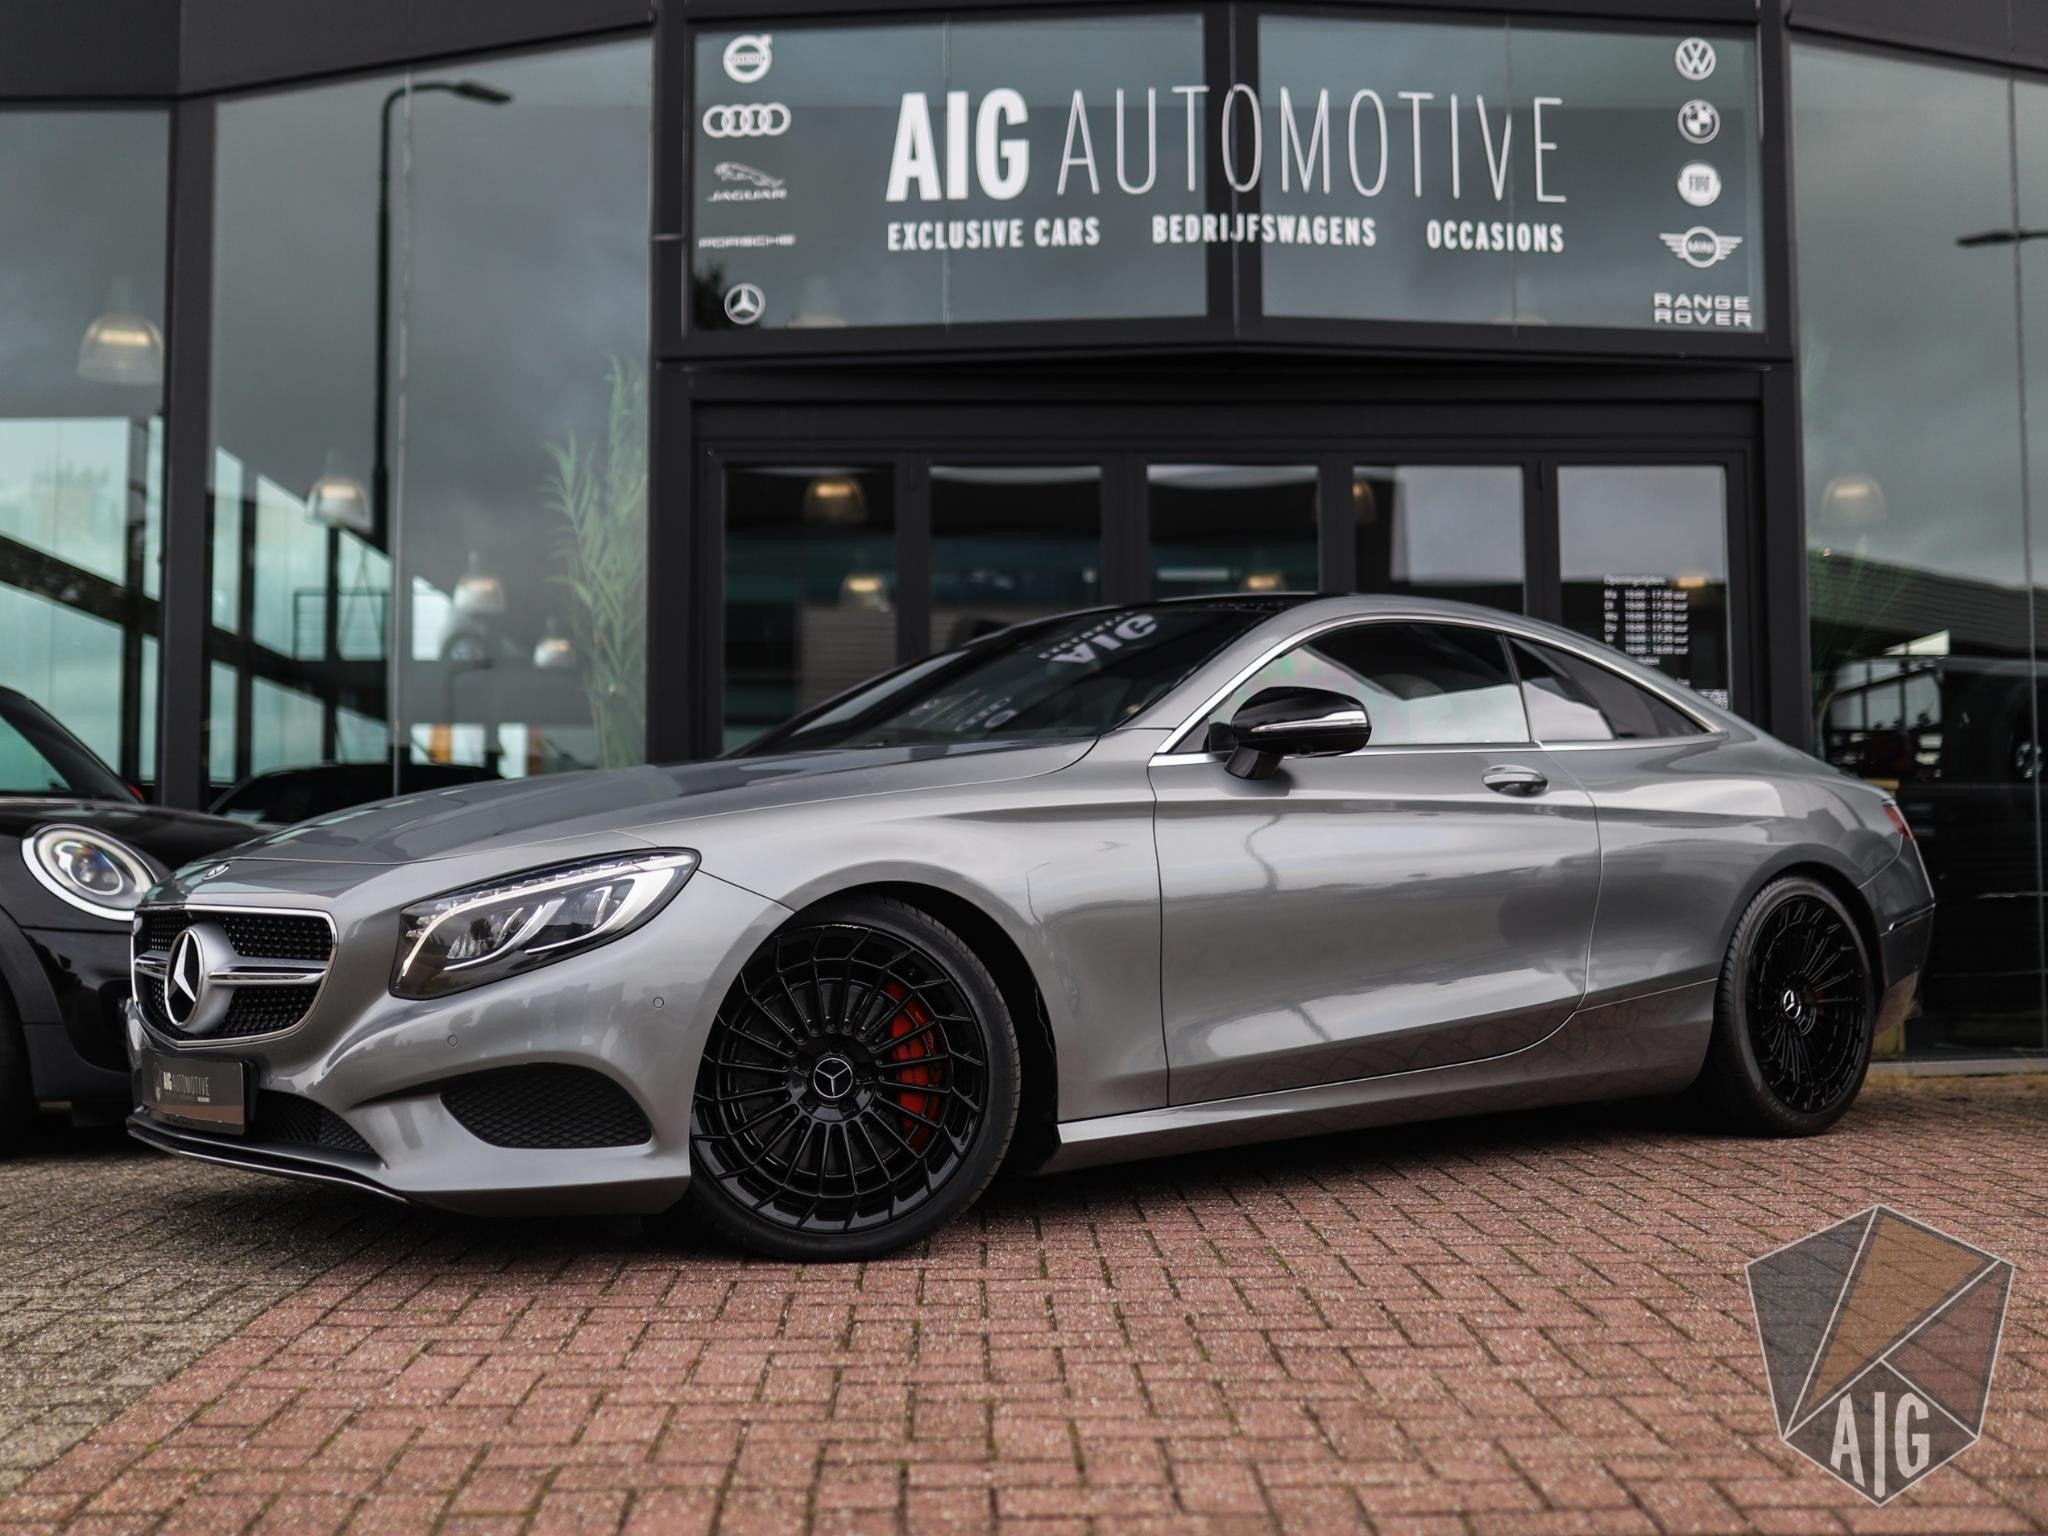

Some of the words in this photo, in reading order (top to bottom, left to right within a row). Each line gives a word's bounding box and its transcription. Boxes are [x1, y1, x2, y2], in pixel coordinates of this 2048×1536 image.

[886, 88, 1030, 201] AIG
[1057, 84, 1567, 204] AUTOMOTIVE
[887, 218, 1025, 252] EXCLUSIVE
[1034, 216, 1101, 248] CARS
[1151, 213, 1377, 247] BEDRIJFSWAGENS
[1426, 218, 1565, 254] OCCASIONS
[1653, 292, 1750, 311] RANGE
[1653, 308, 1752, 327] ROVER
